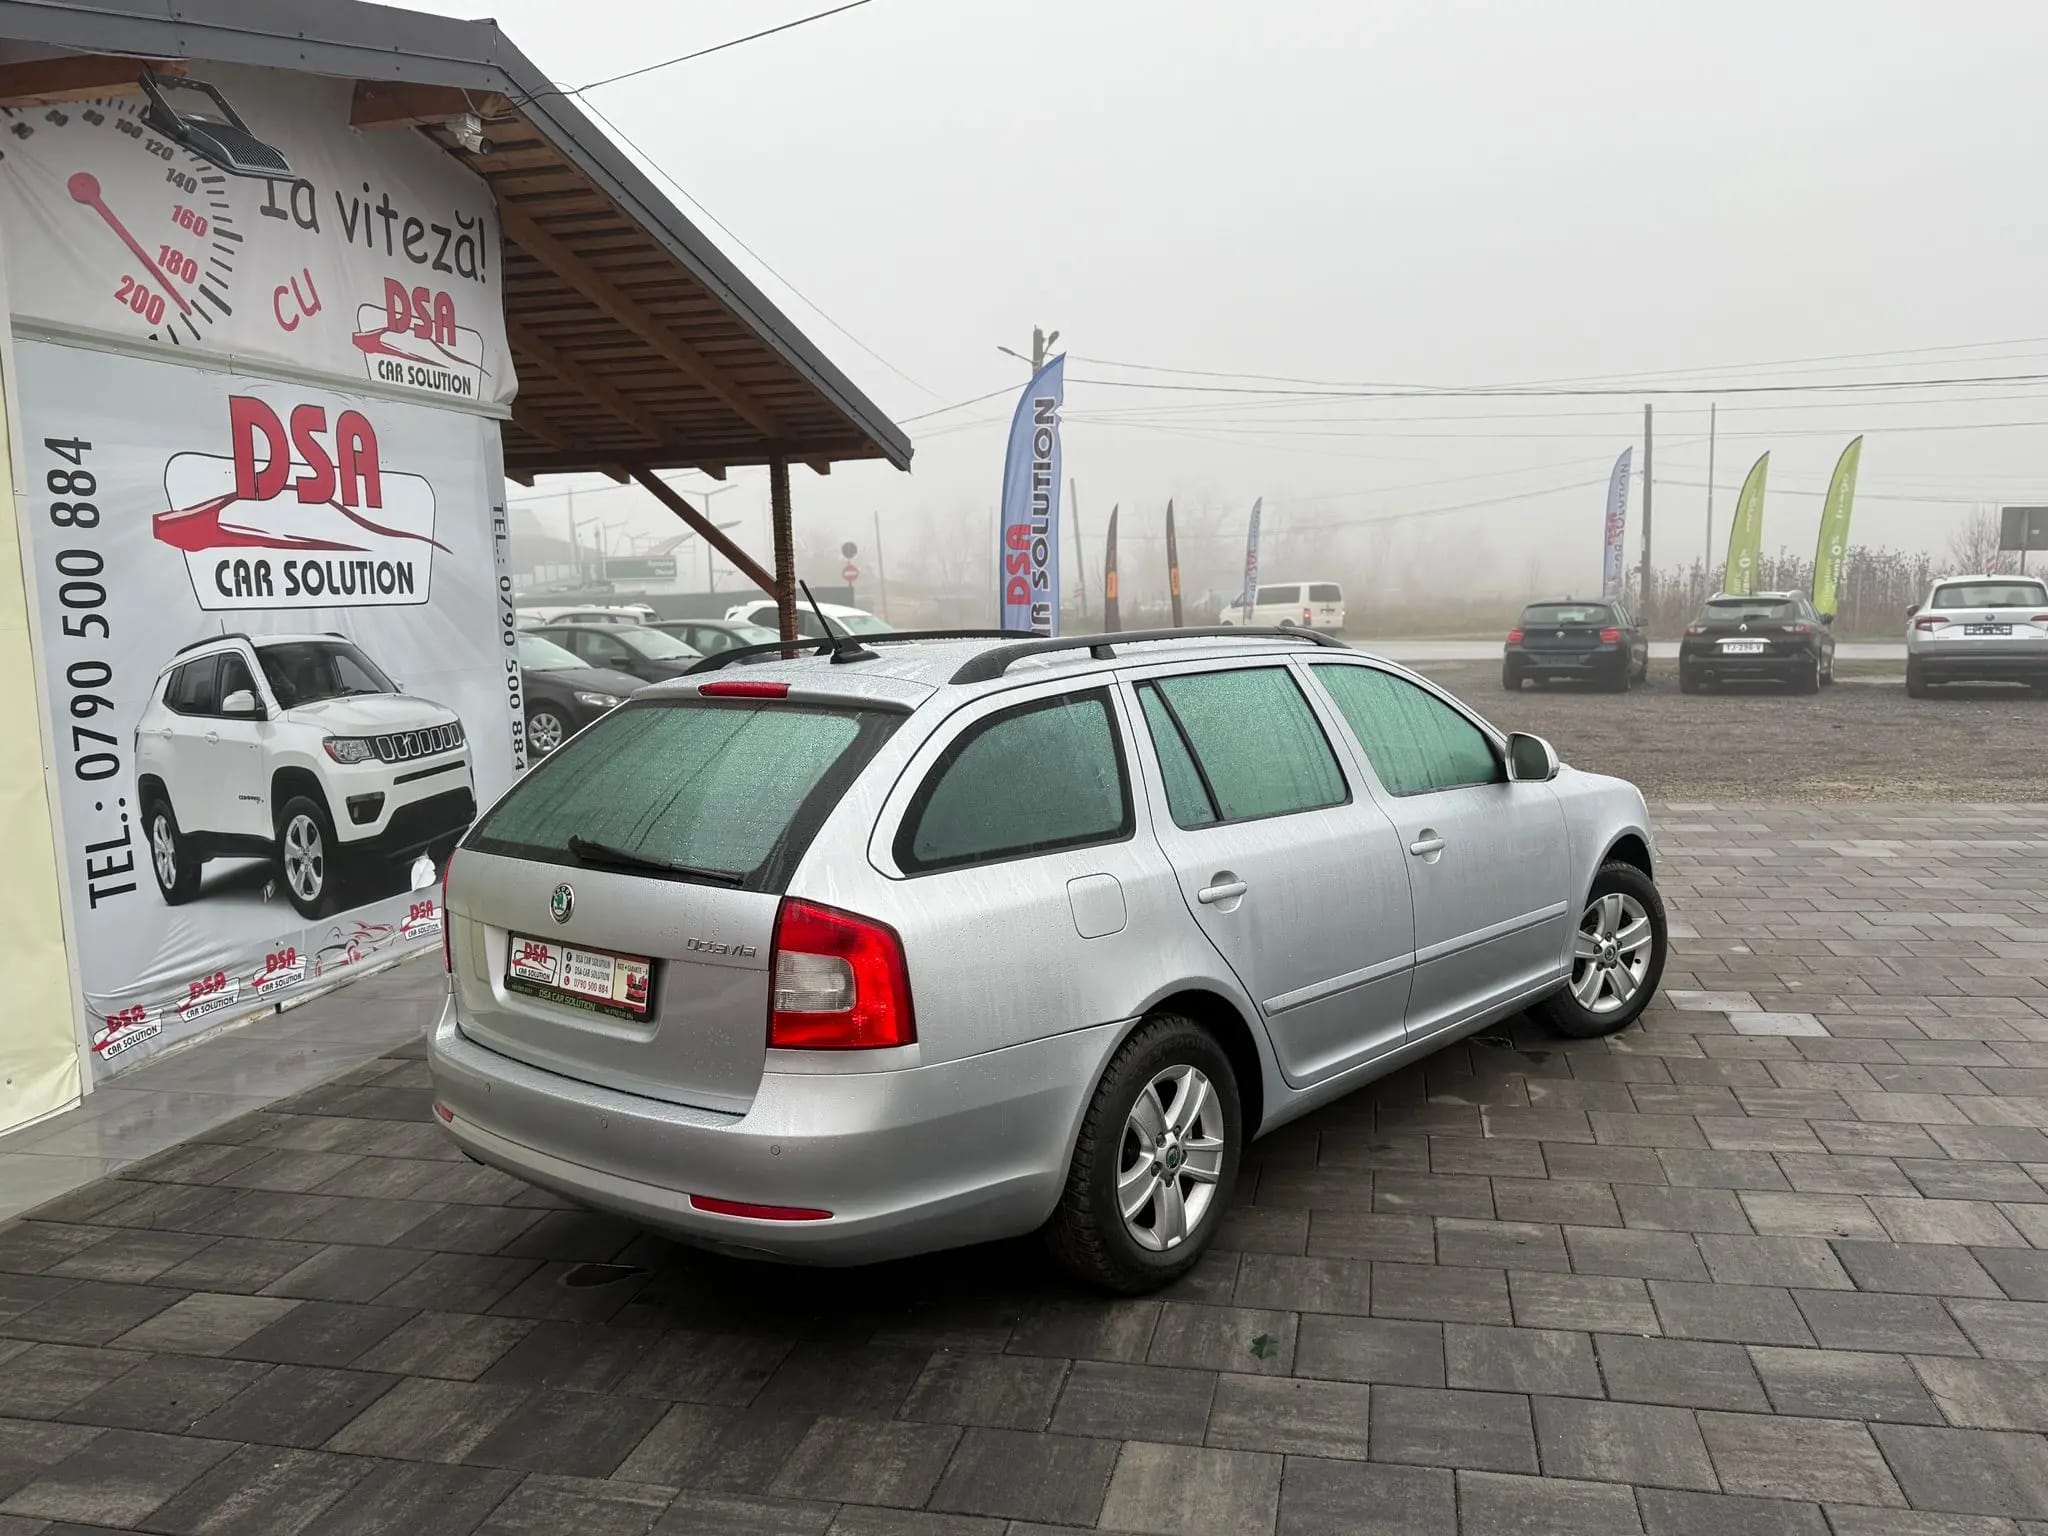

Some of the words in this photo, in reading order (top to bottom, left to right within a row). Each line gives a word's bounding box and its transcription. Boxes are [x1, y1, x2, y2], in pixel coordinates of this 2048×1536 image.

[115, 118, 143, 139] 100
[145, 138, 175, 161] 120
[166, 168, 198, 194] 140
[171, 205, 208, 237] 160
[335, 182, 486, 284] viteză!
[157, 245, 198, 284] 180
[114, 275, 165, 325] 200
[273, 268, 322, 332] cu
[384, 277, 456, 347] DSA
[378, 359, 403, 383] CAR
[408, 366, 471, 396] SOLUTION
[229, 395, 382, 509] DSA
[44, 436, 100, 528] 884
[1032, 397, 1056, 590] SOLUTION
[215, 559, 274, 597] CAR
[283, 560, 415, 597] SOLUTION
[1006, 524, 1032, 606] DSA
[55, 549, 110, 639] 500
[500, 575, 516, 648] 0790
[505, 657, 522, 709] 500
[66, 661, 120, 781] 0790
[512, 721, 526, 772] 884
[410, 900, 434, 920] DSA
[408, 929, 417, 938] CAR
[417, 922, 439, 935] SOLUTION
[266, 947, 296, 973] DSA
[524, 942, 548, 964] DSA
[189, 971, 226, 1000] DSA
[262, 982, 274, 993] CAR
[275, 973, 302, 989] SOLUTION
[518, 967, 528, 975] CAR
[528, 969, 551, 981] SOLUTION
[574, 978, 587, 990] 0790
[588, 981, 598, 992] 500
[598, 984, 609, 995] 884
[186, 1007, 200, 1019] CAR
[200, 996, 234, 1014] SOLUTION
[539, 989, 551, 999] DSA
[552, 993, 564, 1003] CAR
[565, 996, 596, 1011] SOLUTION
[107, 1041, 123, 1056] CAR
[122, 1025, 158, 1048] SOLUTION
